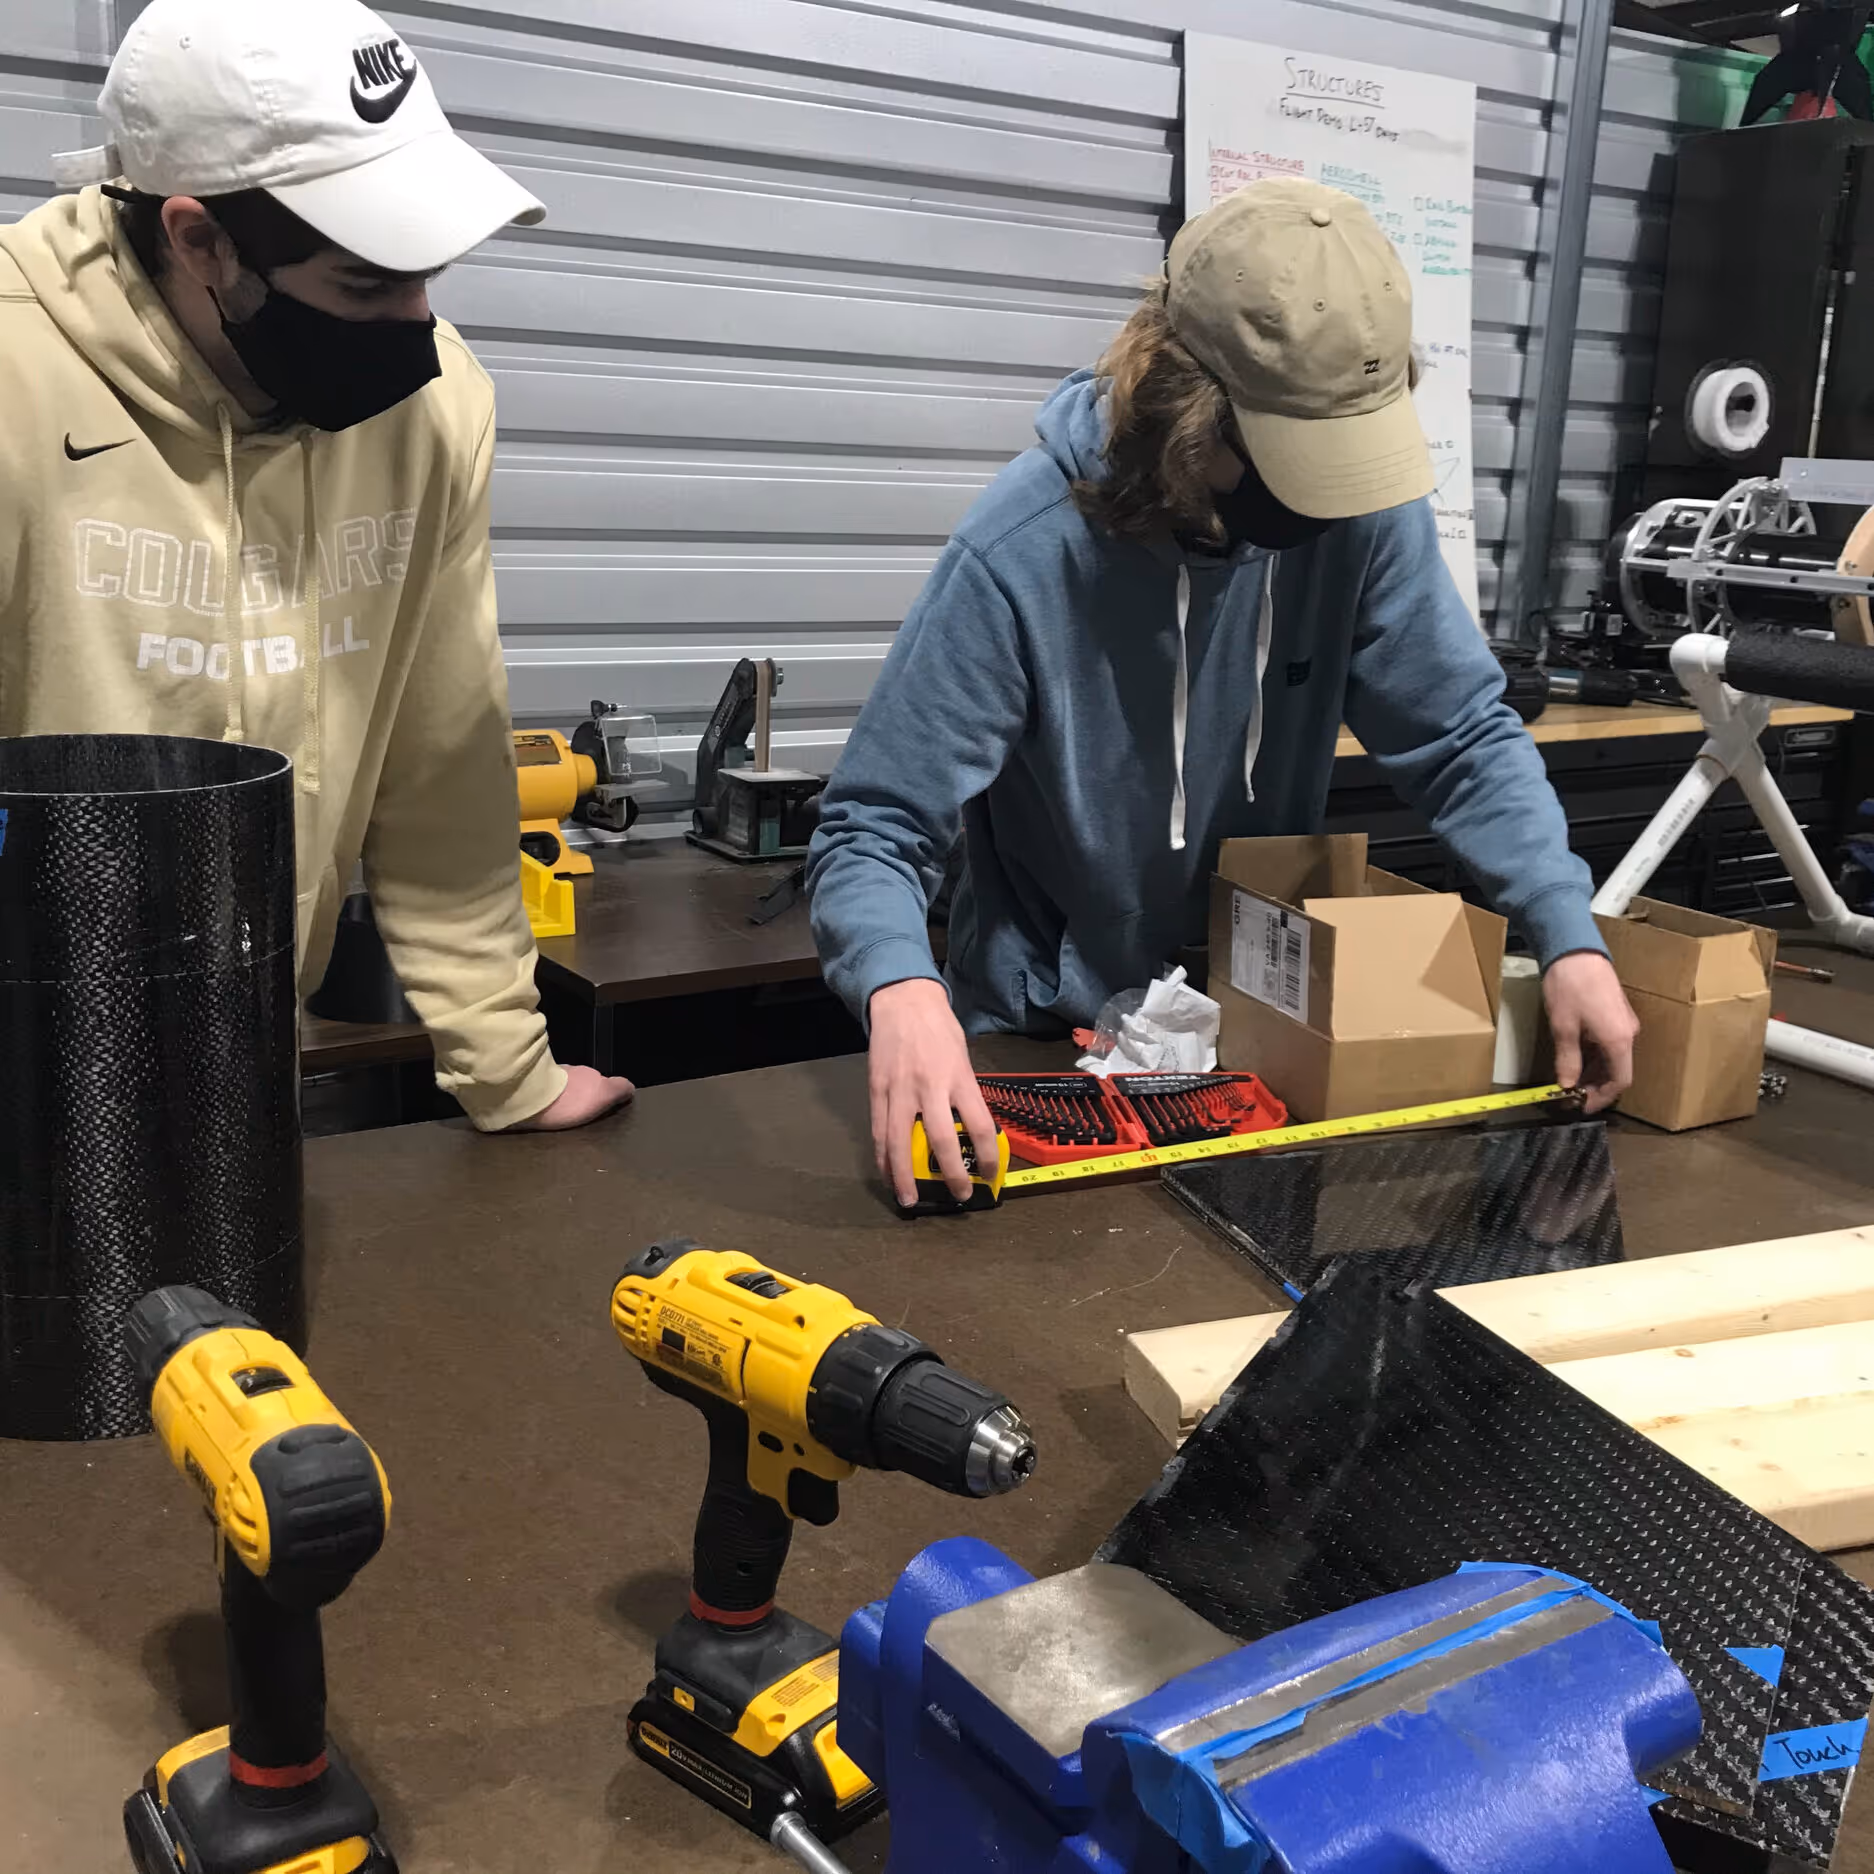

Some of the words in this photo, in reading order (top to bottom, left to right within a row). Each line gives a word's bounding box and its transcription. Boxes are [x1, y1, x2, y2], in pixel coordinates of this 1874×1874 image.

[352, 38, 416, 90] NIKE
[1284, 56, 1385, 102] STRUCTURES
[136, 615, 370, 680] FOOTBLL
[1123, 1074, 1200, 1082] TEKTON
[1772, 1735, 1854, 1770] Touch
